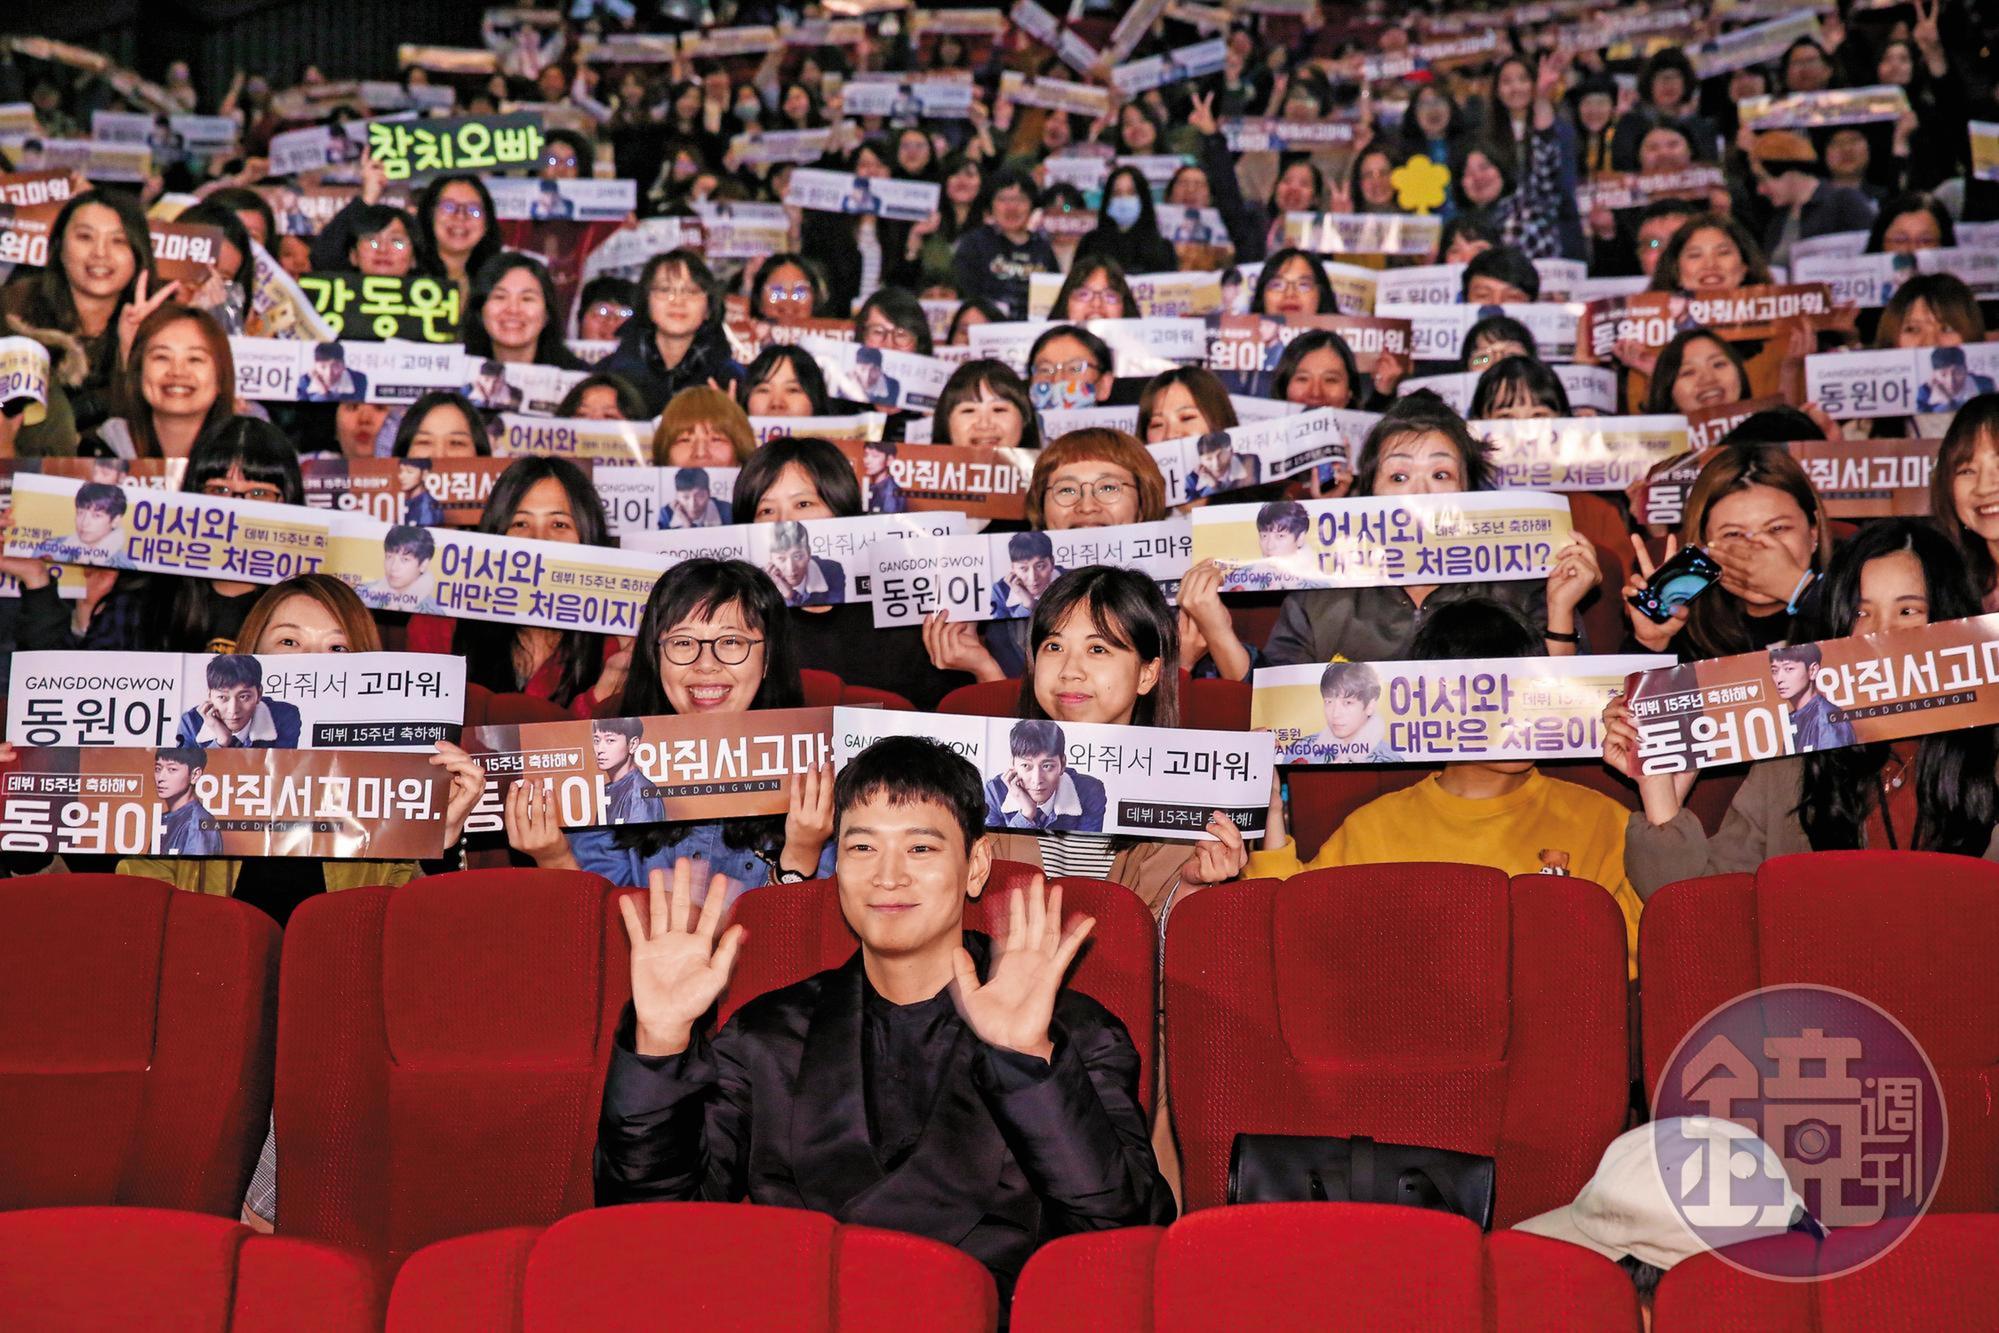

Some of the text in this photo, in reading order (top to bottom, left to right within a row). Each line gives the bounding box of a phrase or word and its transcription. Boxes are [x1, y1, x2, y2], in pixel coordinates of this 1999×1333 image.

[369, 122, 544, 180] 참치오빠
[237, 365, 293, 394] 원아
[1819, 378, 1910, 413] 동원아
[510, 425, 578, 451] 어서와
[888, 458, 1031, 495] 와줘서고마
[1801, 455, 1938, 490] 줘서고마
[133, 501, 239, 544] 어서와
[244, 527, 268, 542] 데뷔
[273, 530, 310, 546] 15주년
[1510, 519, 1552, 532] 축하해!
[128, 536, 210, 571] 대만은
[441, 543, 545, 587] 어서와
[551, 570, 575, 584] 데뷔
[579, 574, 616, 590] 15주년
[879, 555, 984, 573] GANGDONGWON
[1056, 540, 1123, 567] 와줘서
[1416, 542, 1551, 577] 처음이지?
[435, 581, 648, 629] 대만은 처음이지
[25, 676, 174, 692] GANGDONGWON
[264, 671, 450, 700] 와줘서 고마워.
[1390, 673, 1514, 717] 어서와
[1664, 694, 1704, 713] 15주년
[1829, 692, 1974, 723] GANGDONGWON
[320, 724, 447, 743] 데뷔 15주년 축하해!
[1389, 716, 1605, 754] 대만은 처음이
[486, 757, 525, 772] 15주년
[634, 733, 834, 783] 와줘서고마
[1068, 743, 1258, 782] 와줘서 고마워.
[1275, 742, 1370, 757] ANGDONGWON
[8, 776, 36, 792] 데뷔
[40, 777, 81, 794] 15주년
[643, 781, 779, 798] GANGDONGWON
[1126, 807, 1154, 823] 데뷔
[1158, 810, 1203, 827] 15주년
